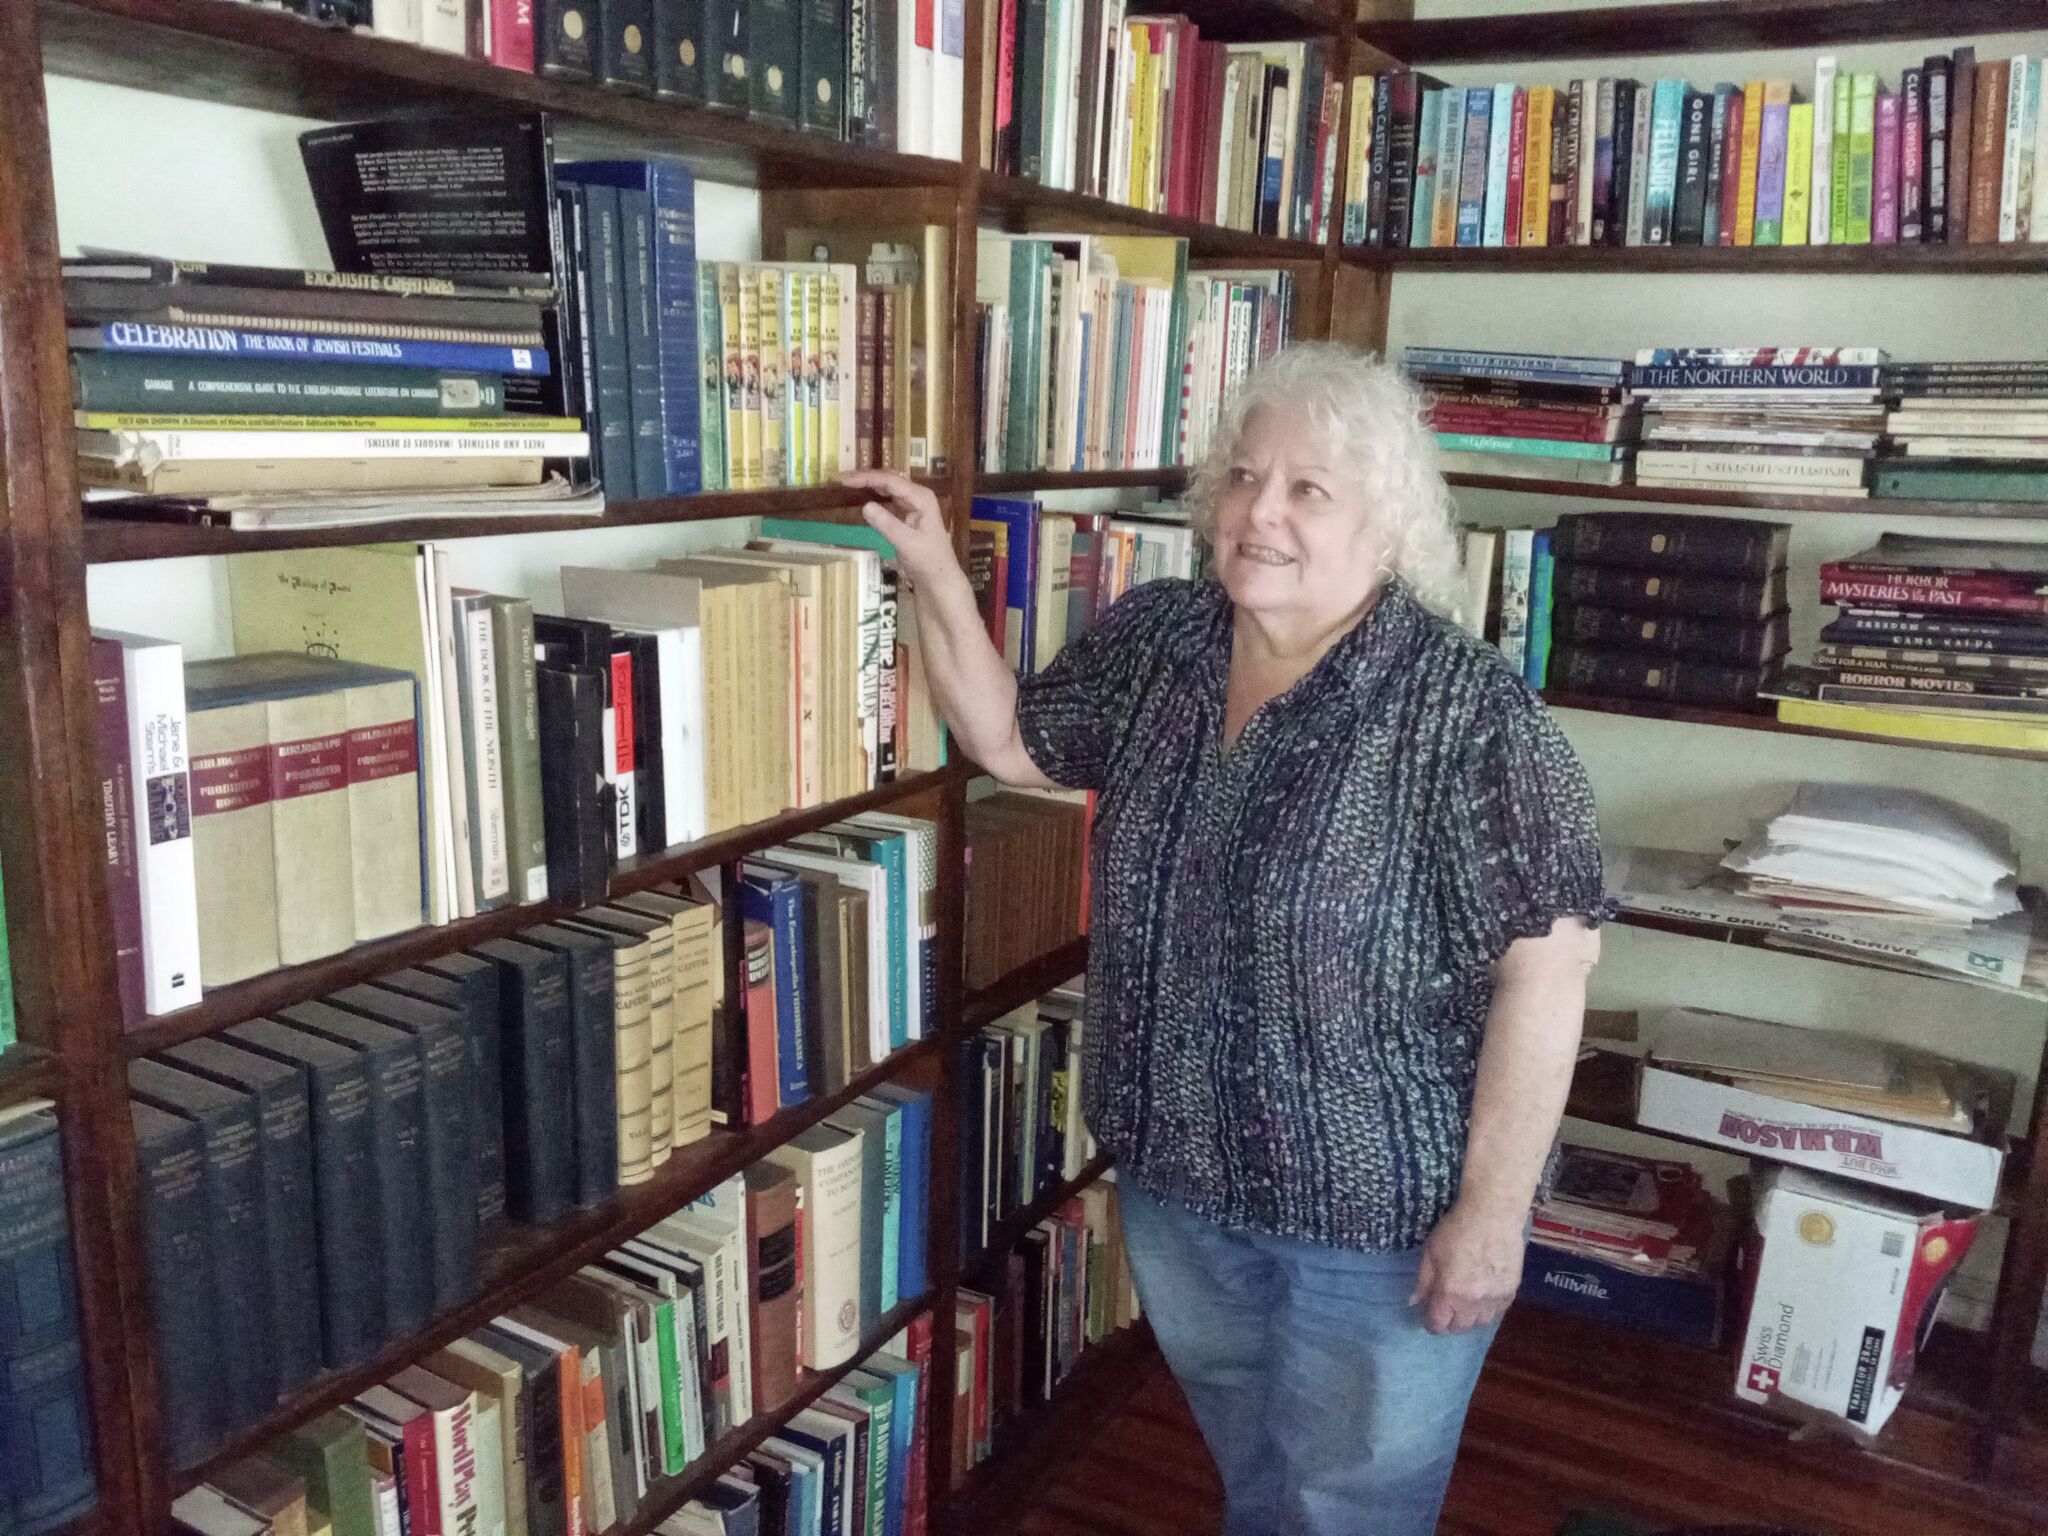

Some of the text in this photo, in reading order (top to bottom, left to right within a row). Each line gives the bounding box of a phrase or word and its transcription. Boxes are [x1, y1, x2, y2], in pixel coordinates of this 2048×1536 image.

[1377, 76, 1388, 113] LINDA
[1373, 115, 1386, 174] CASTILLO
[1687, 98, 1704, 184] GONE GIRL
[304, 271, 379, 289] EXQUISITE
[111, 321, 402, 358] CELEBRATION THE BOOK OF JEWISH FESTIVALS
[188, 380, 195, 391] A
[277, 383, 286, 394] TO
[1650, 367, 1849, 385] THE NORTHERN WORLD
[364, 438, 546, 450] FACES AND DESTINIES (MASQUES ET DESTINS)
[1827, 582, 1909, 601] MYSTERIES
[1929, 590, 1962, 605] PAST
[1887, 574, 1950, 588] HORROR
[521, 626, 531, 665] Today
[1818, 657, 1837, 666] ONE
[1838, 658, 1855, 667] FOR
[1839, 673, 1975, 693] HORROR MOVIES
[477, 620, 498, 790] THE BOOK OF THE MONTH
[156, 713, 170, 772] Michael
[170, 717, 184, 769] Jane &
[101, 778, 119, 866] TIMOTHY LEARY
[619, 785, 630, 834] TDK
[1660, 904, 1920, 957] DON'T DRINK AND DRIVE
[1842, 1156, 1898, 1175] WHO BUT
[1544, 1271, 1610, 1299] Millville
[1752, 1326, 1773, 1364] Swiss
[1767, 1301, 1794, 1370] Diamond
